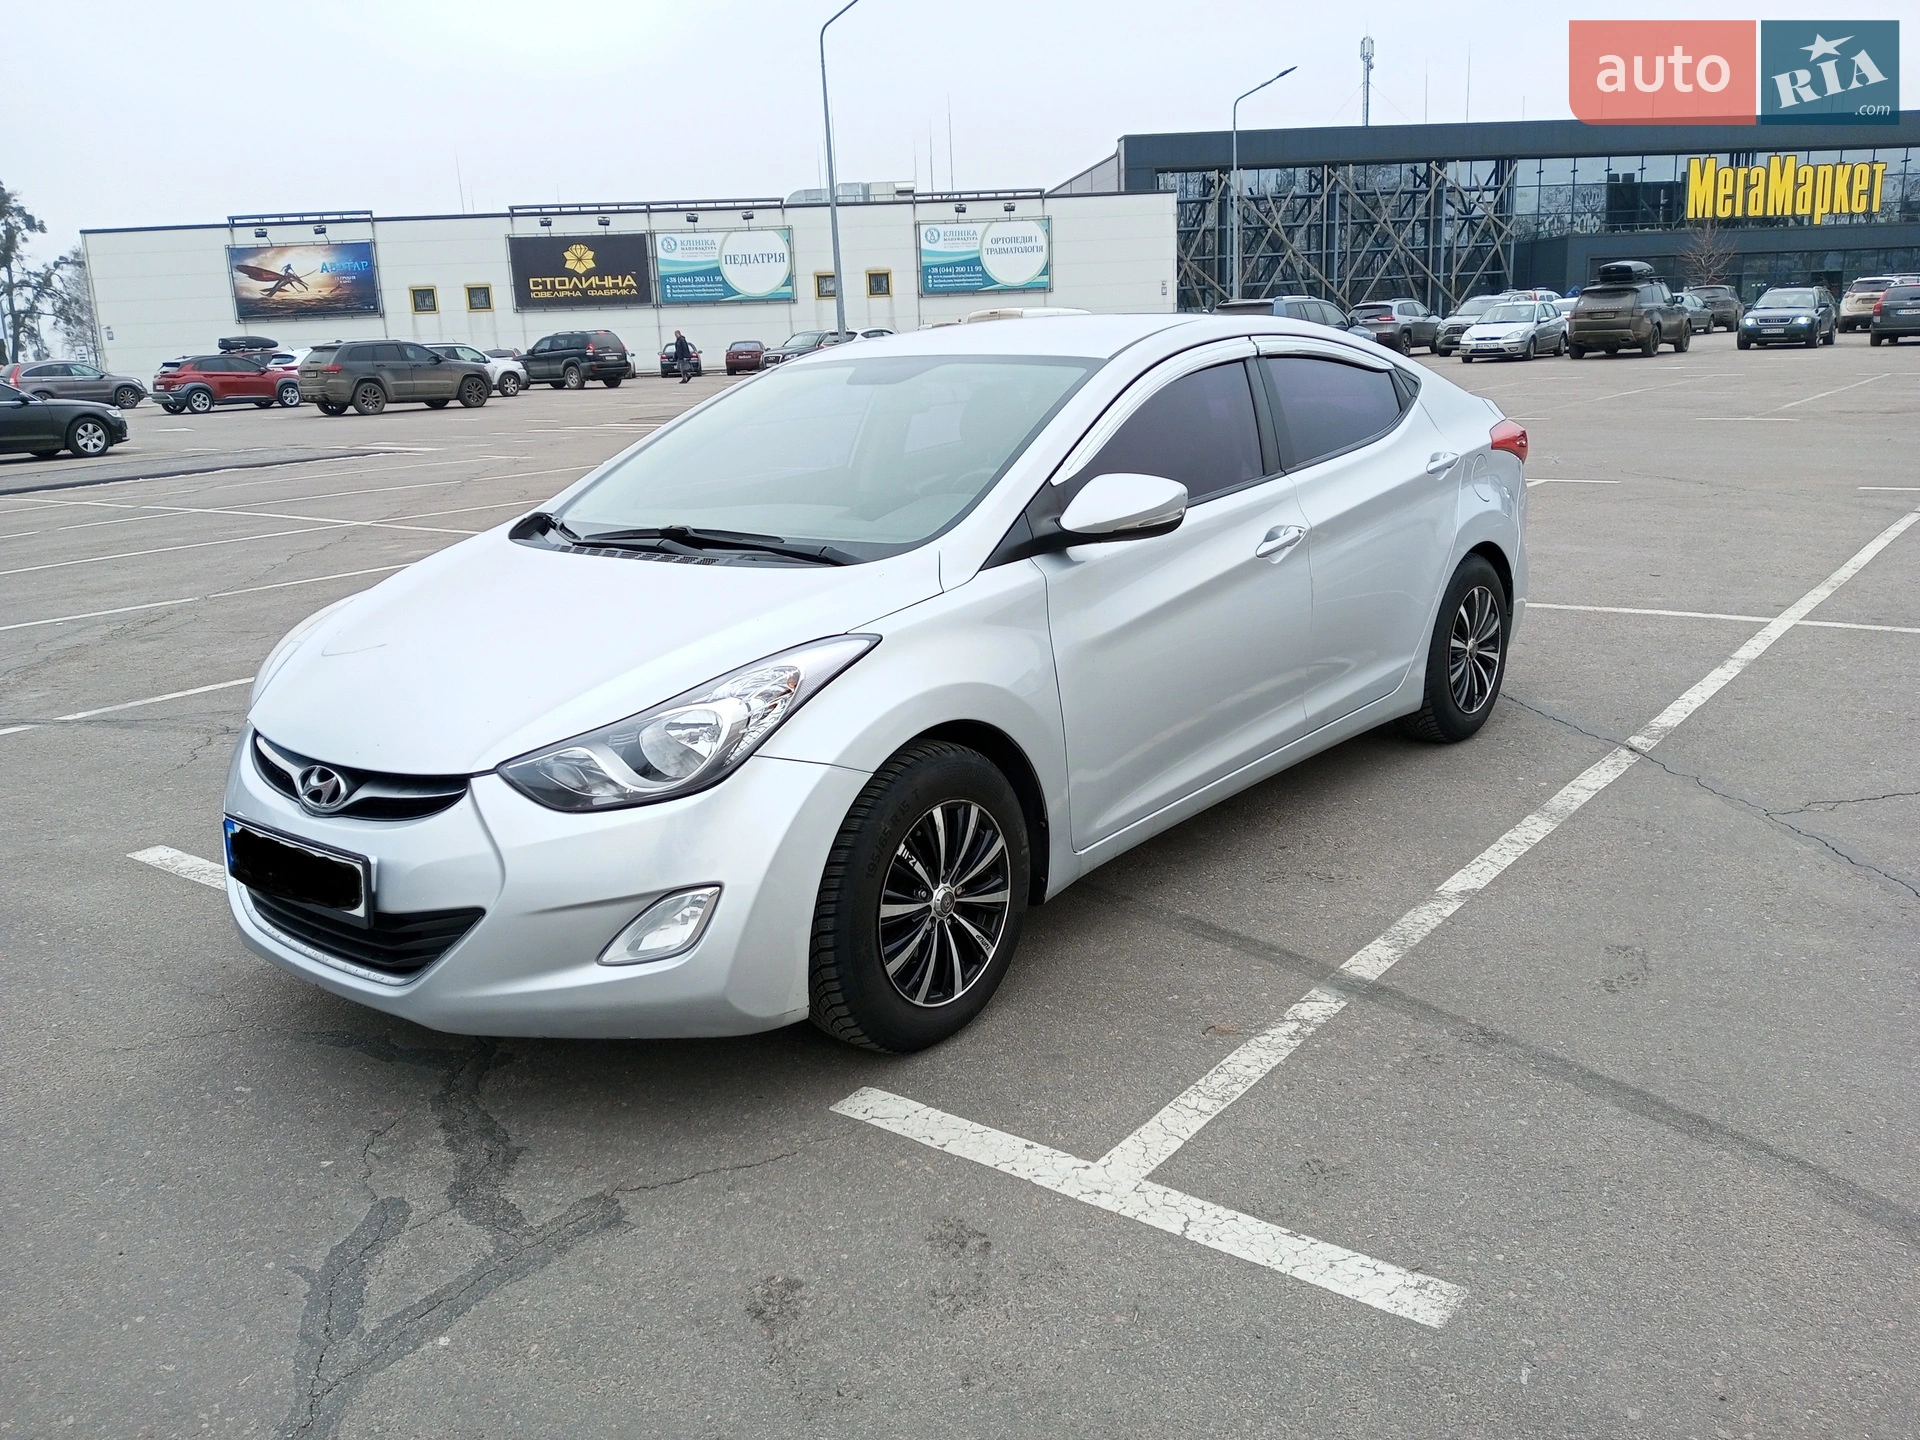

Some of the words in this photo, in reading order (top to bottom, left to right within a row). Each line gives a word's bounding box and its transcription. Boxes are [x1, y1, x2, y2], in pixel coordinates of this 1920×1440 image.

[1685, 154, 1887, 226] МегаМаркет
[680, 239, 716, 247] КЛІНІКА
[990, 235, 1032, 245] ОРТОПЕДІЯ
[984, 245, 1044, 256] ТРАВМАТОЛОГІЯ
[724, 252, 786, 266] ПЕДІАТРІЯ
[320, 259, 368, 273] АВАТАР
[529, 275, 638, 290] СТОЛИЧНА
[530, 289, 582, 298] ЮВЕЛІРНА
[587, 288, 638, 297] ФАБРИКА
